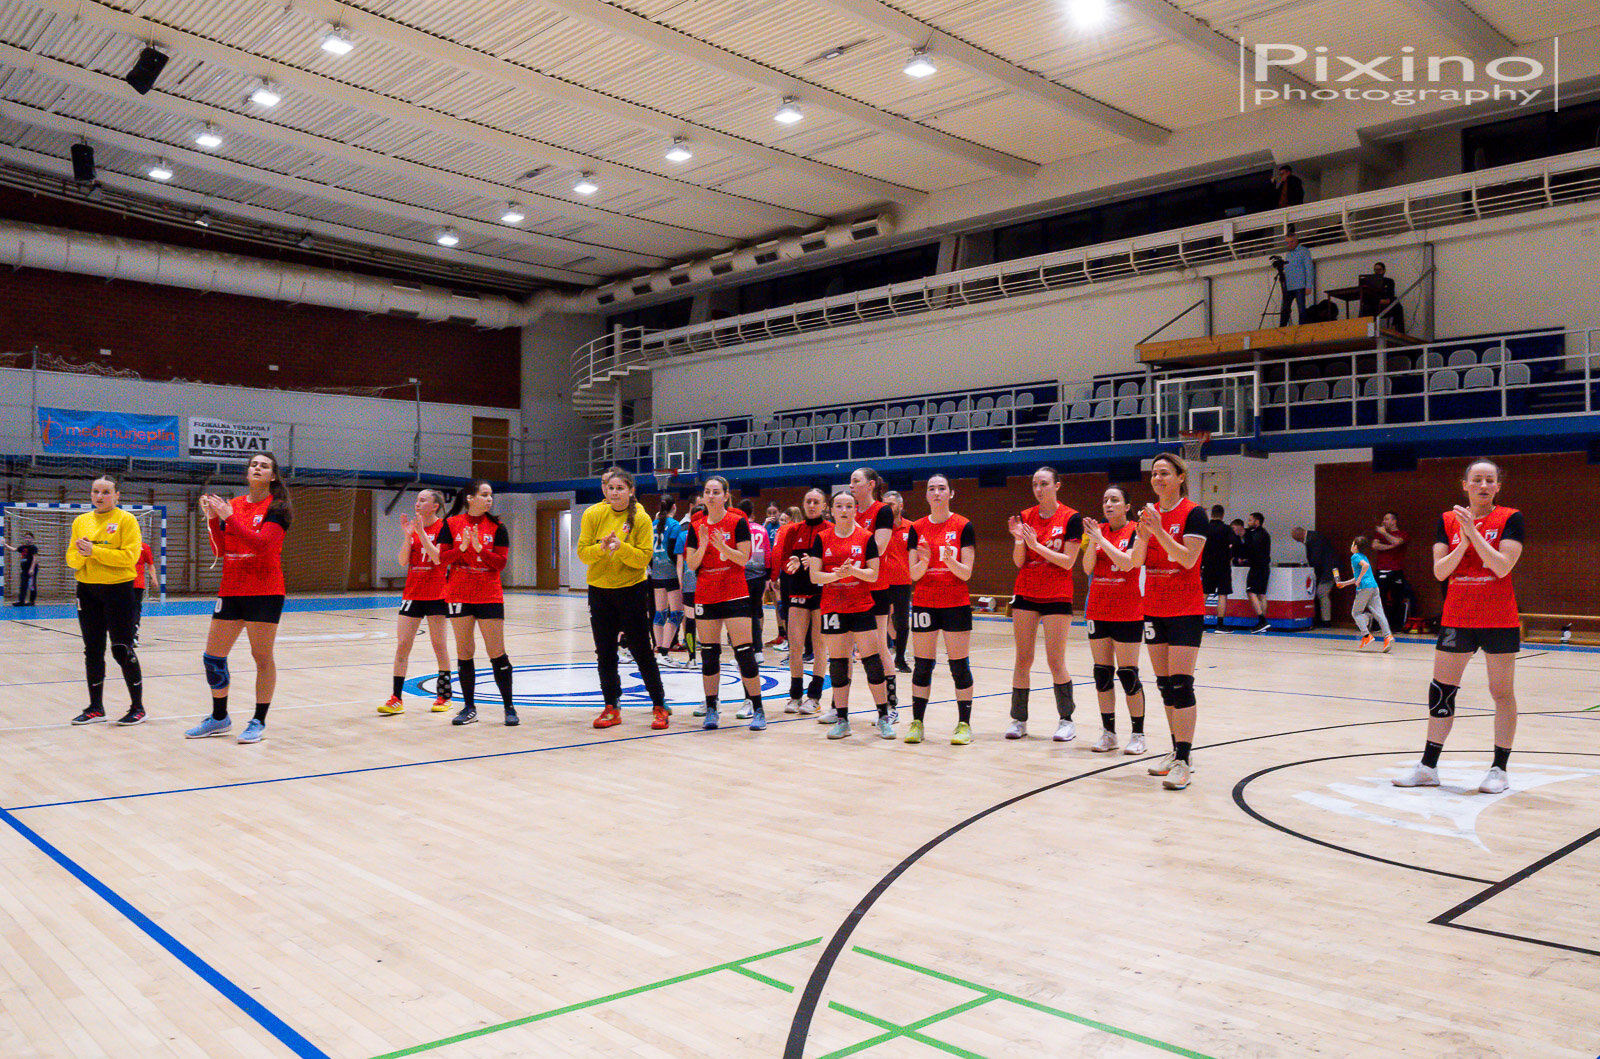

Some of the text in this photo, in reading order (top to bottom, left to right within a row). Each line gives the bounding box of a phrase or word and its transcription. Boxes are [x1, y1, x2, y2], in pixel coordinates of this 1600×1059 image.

[194, 433, 269, 450] HORVAT
[751, 533, 764, 553] 12
[823, 613, 840, 630] 14
[913, 612, 932, 629] 10
[1442, 628, 1457, 648] 2
